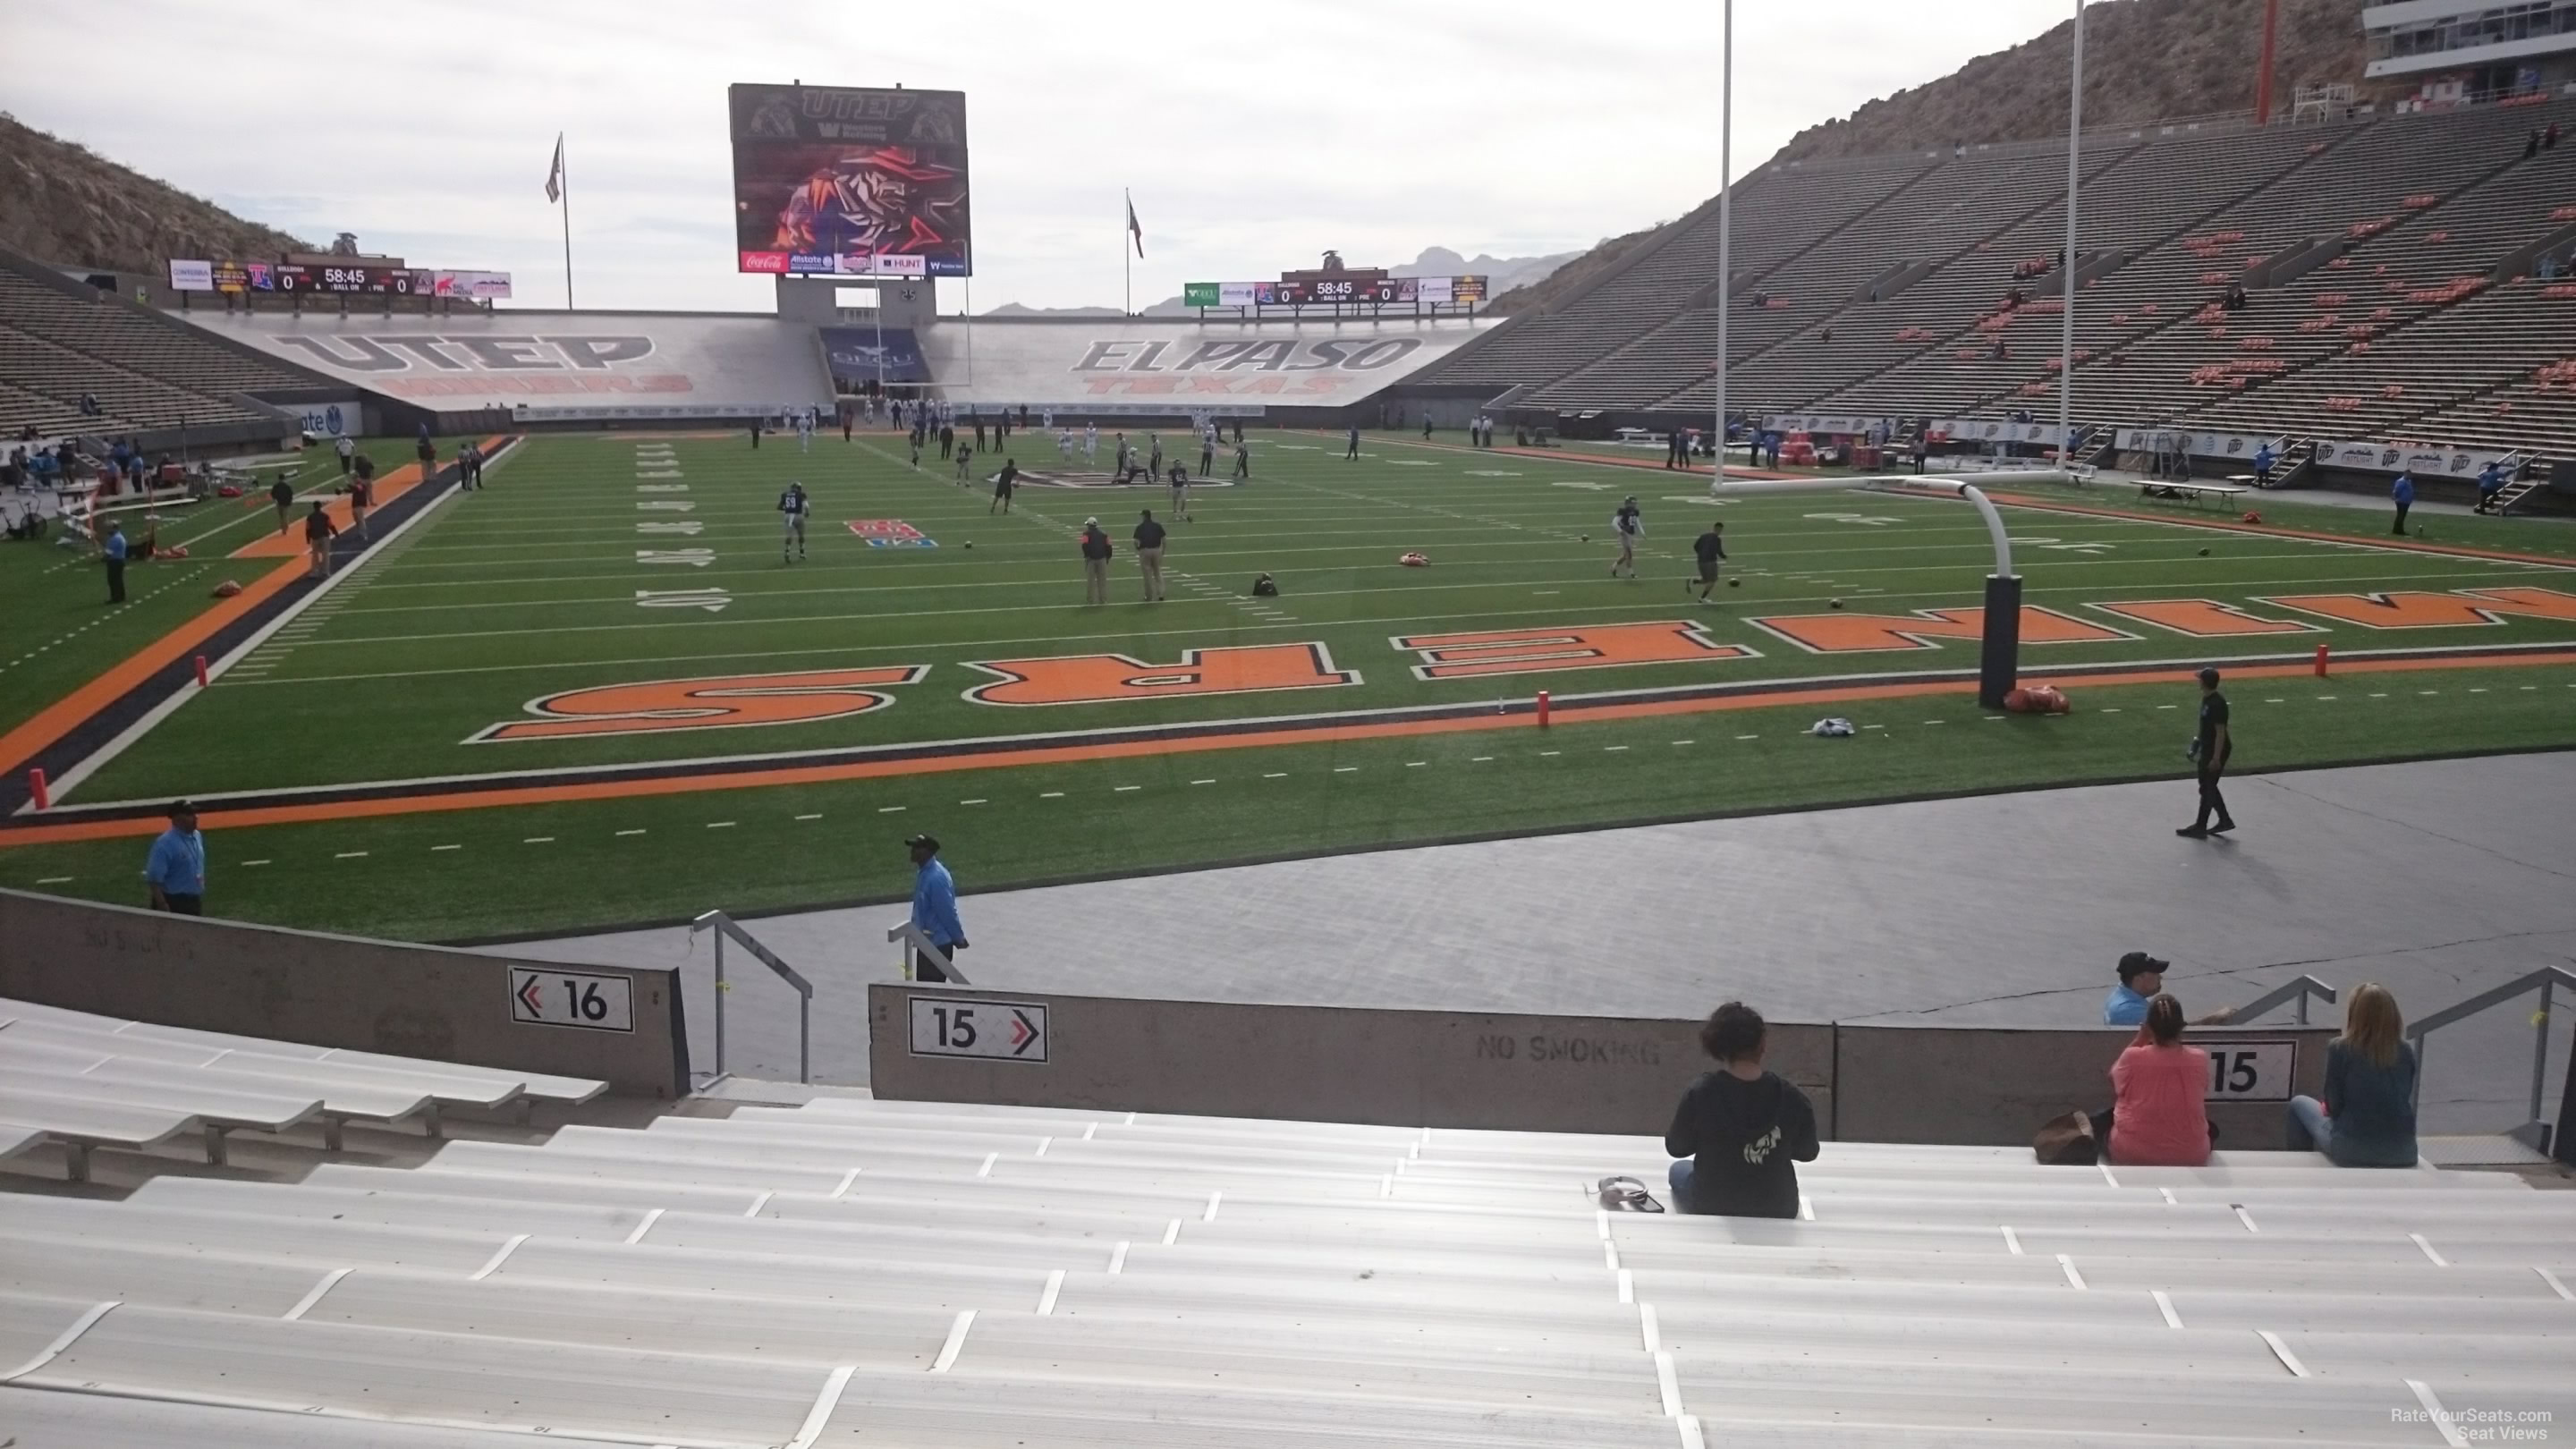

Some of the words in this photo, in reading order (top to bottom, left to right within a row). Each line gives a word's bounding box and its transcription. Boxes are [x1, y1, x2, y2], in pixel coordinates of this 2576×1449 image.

[802, 89, 918, 121] UTEP
[791, 255, 823, 264] Allstate
[894, 258, 921, 268] HUNT
[284, 275, 293, 290] 0
[325, 268, 365, 284] 58:45
[397, 279, 407, 292] 0
[1282, 291, 1290, 302] 0
[1317, 282, 1352, 294] 58:45
[1381, 288, 1391, 301] 0
[266, 335, 657, 373] UTEP
[1068, 340, 1174, 373] EL
[1175, 338, 1424, 373] PASO
[371, 375, 694, 397] MINERS
[1083, 375, 1349, 394] TEXAS
[563, 979, 608, 1021] 16
[932, 1007, 977, 1048] 15
[1476, 1034, 1515, 1060] NO
[1530, 1035, 1661, 1066] SMOKING
[2210, 1051, 2258, 1093] 15
